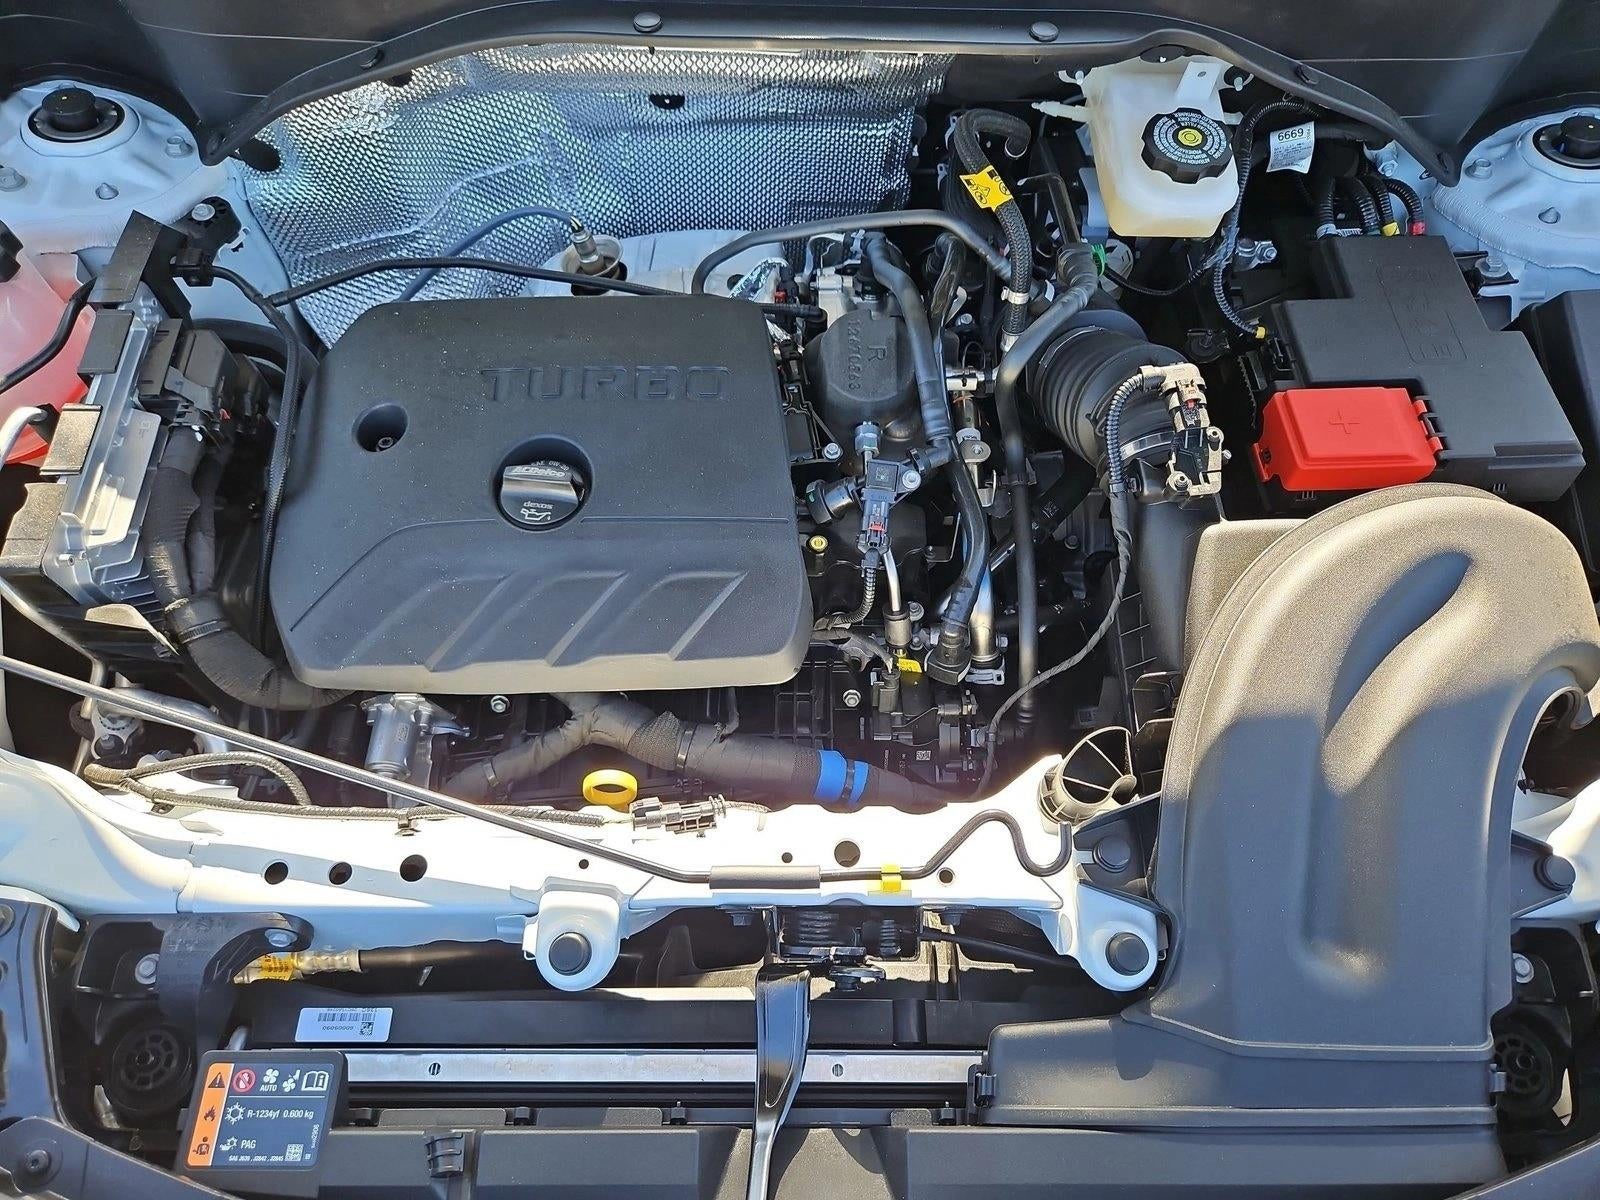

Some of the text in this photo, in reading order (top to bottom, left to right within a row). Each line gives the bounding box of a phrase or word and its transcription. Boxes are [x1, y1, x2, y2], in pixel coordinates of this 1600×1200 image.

[1277, 127, 1304, 141] 6669
[480, 365, 733, 401] TURBO
[511, 466, 566, 477] ACDelco
[523, 501, 554, 510] dexos
[259, 1084, 278, 1092] AUTO
[247, 1109, 314, 1120] R-1234yf 0.600 kg
[240, 1139, 257, 1149] PAG
